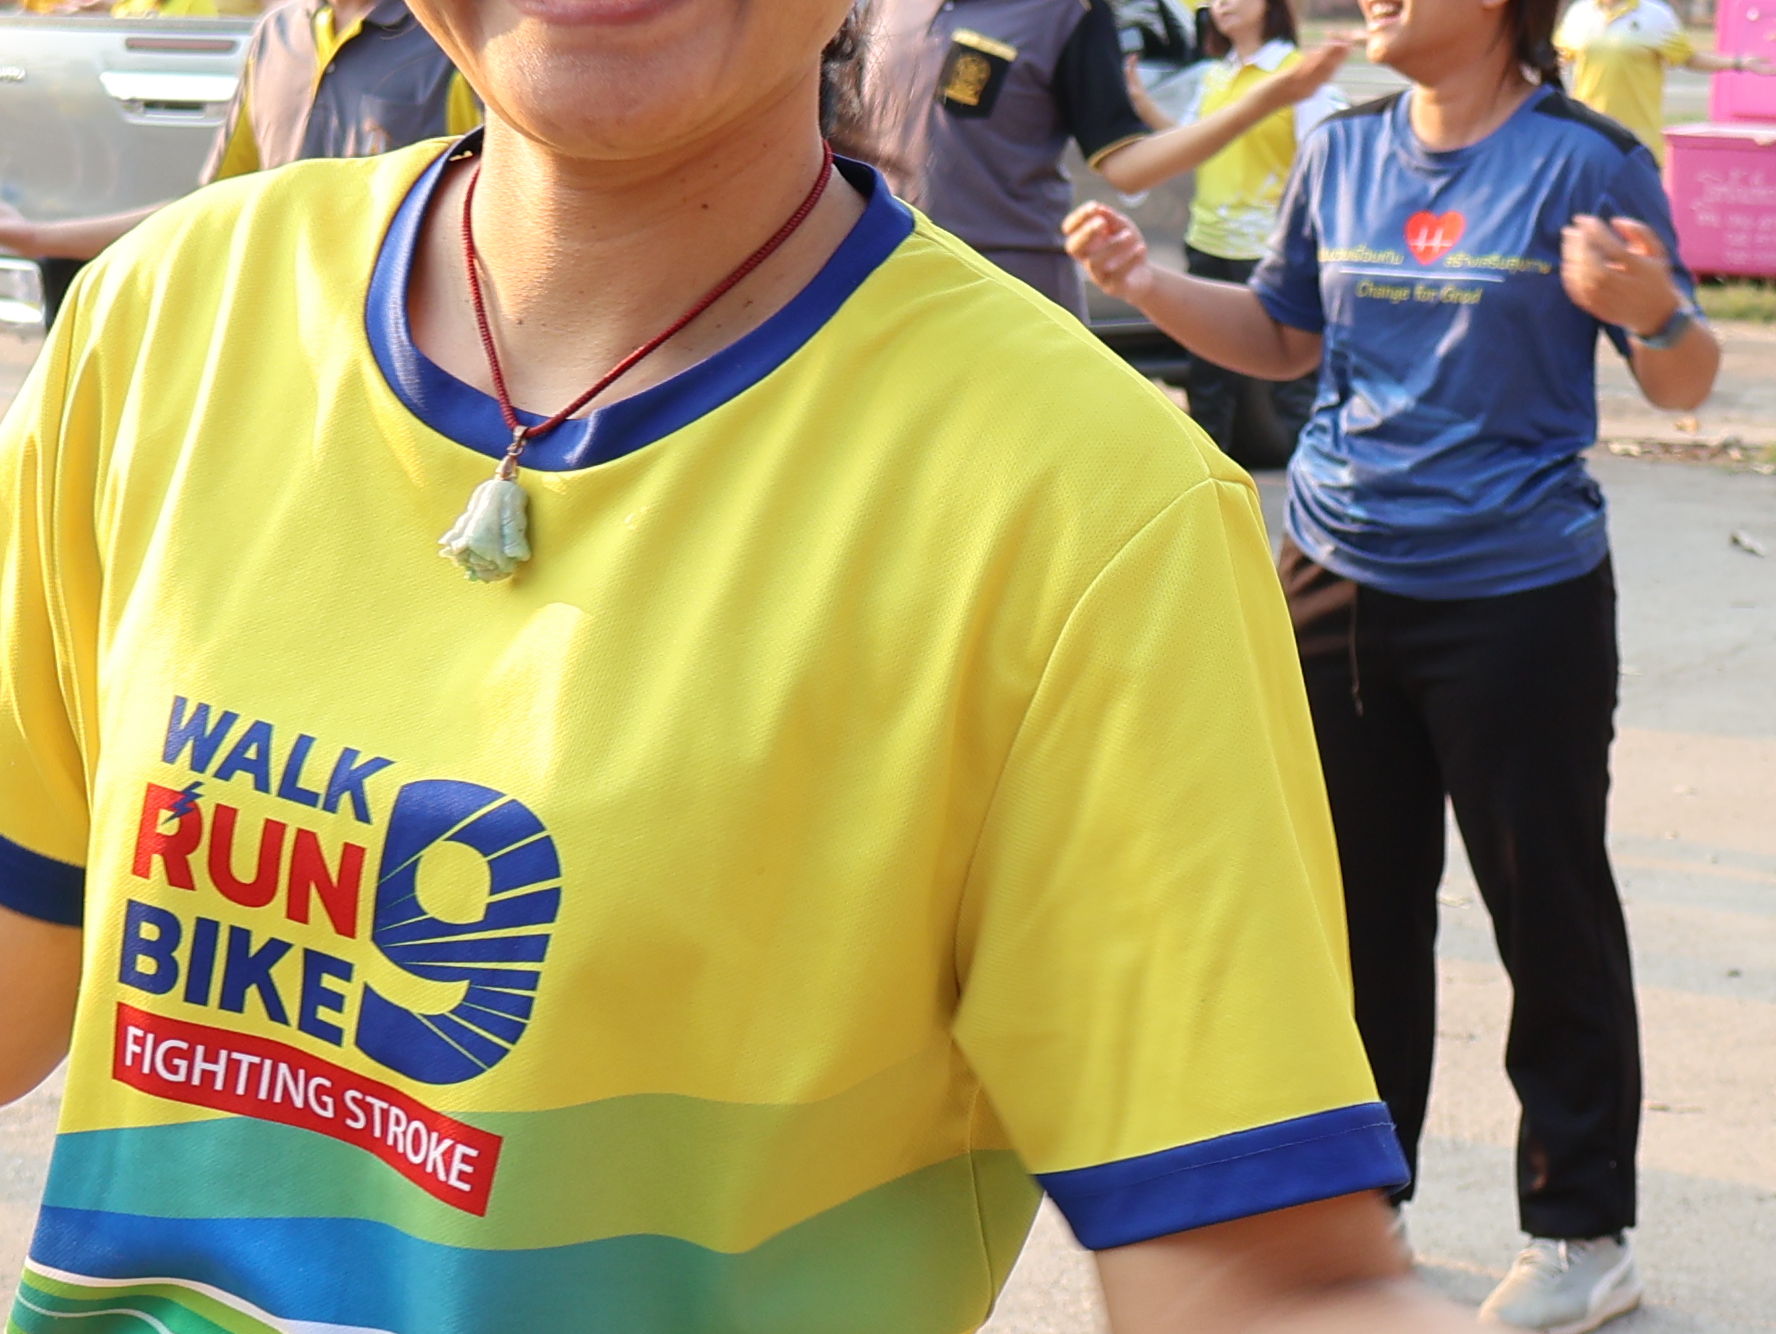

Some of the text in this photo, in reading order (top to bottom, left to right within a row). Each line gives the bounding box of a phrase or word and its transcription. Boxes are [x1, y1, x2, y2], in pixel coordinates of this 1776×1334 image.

[1356, 280, 1484, 304] Change for Good
[162, 695, 396, 825] WALK
[118, 899, 354, 1048] BIKE
[132, 779, 562, 1085] RUN 9
[124, 1026, 479, 1193] FIGHTING STROKE
